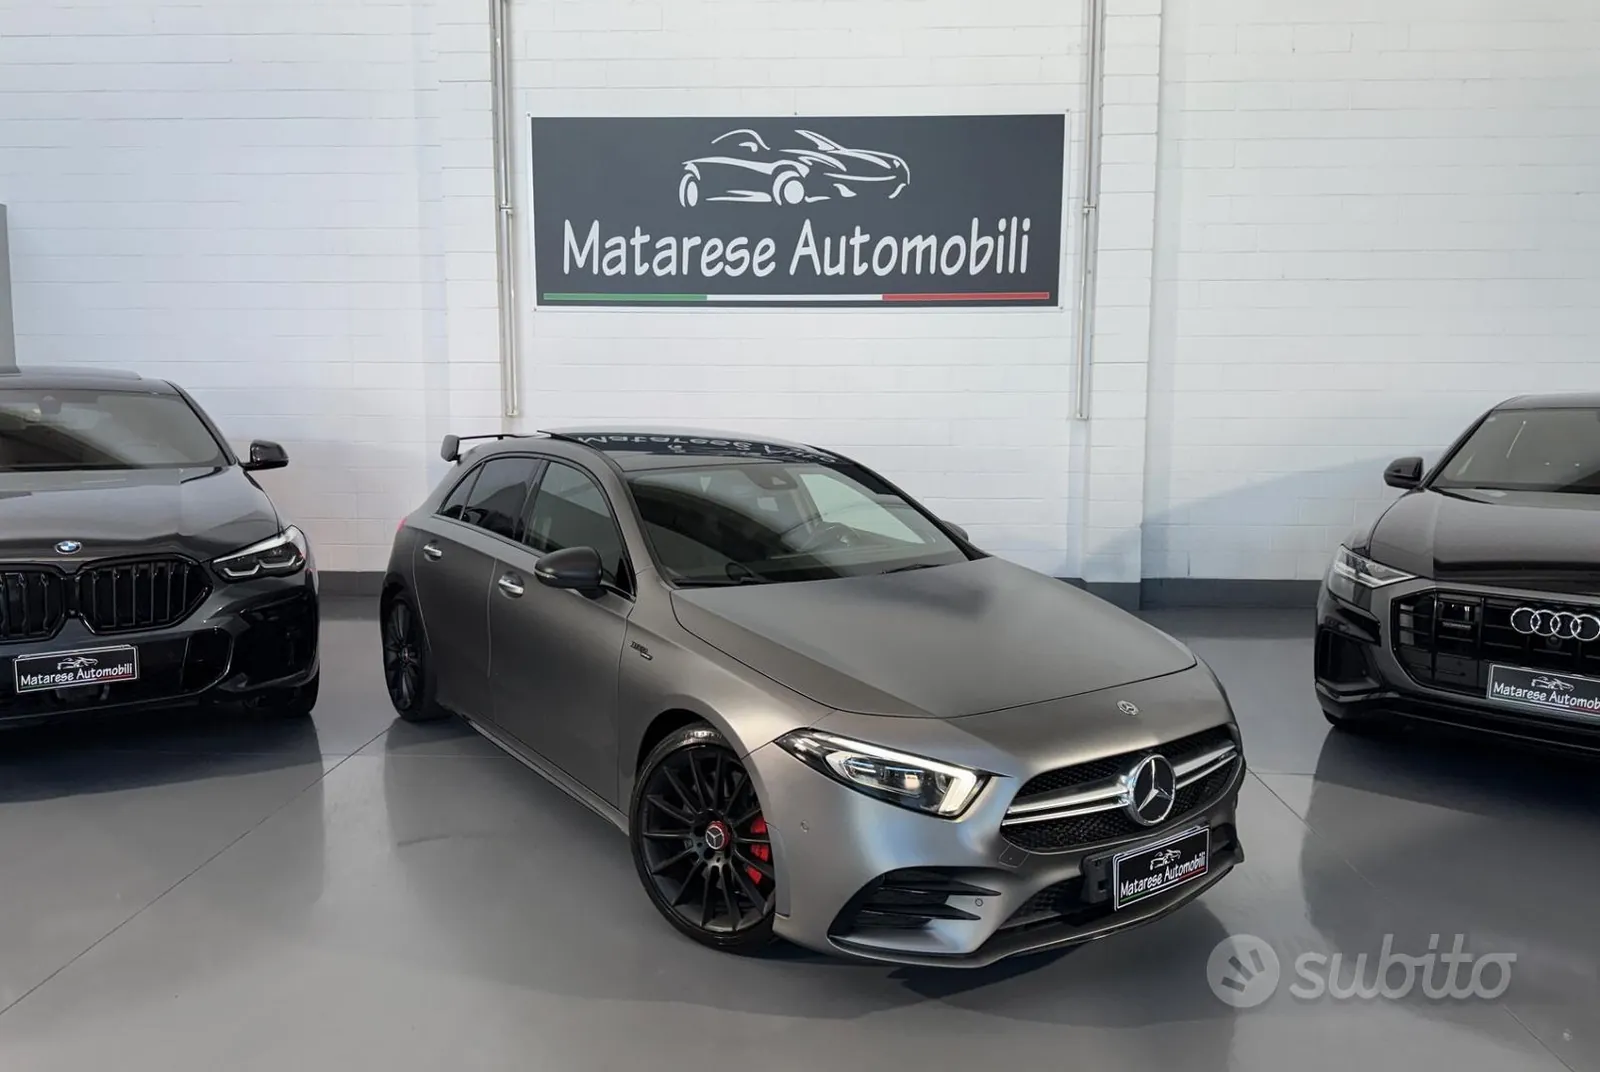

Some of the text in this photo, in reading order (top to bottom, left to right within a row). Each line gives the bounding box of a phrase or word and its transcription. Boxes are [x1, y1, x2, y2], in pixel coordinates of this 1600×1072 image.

[563, 217, 1031, 277] Matarese Automobili
[21, 663, 133, 686] Matarese Automobili
[1493, 682, 1546, 700] Matarese
[1121, 852, 1205, 898] Matarese Automobili
